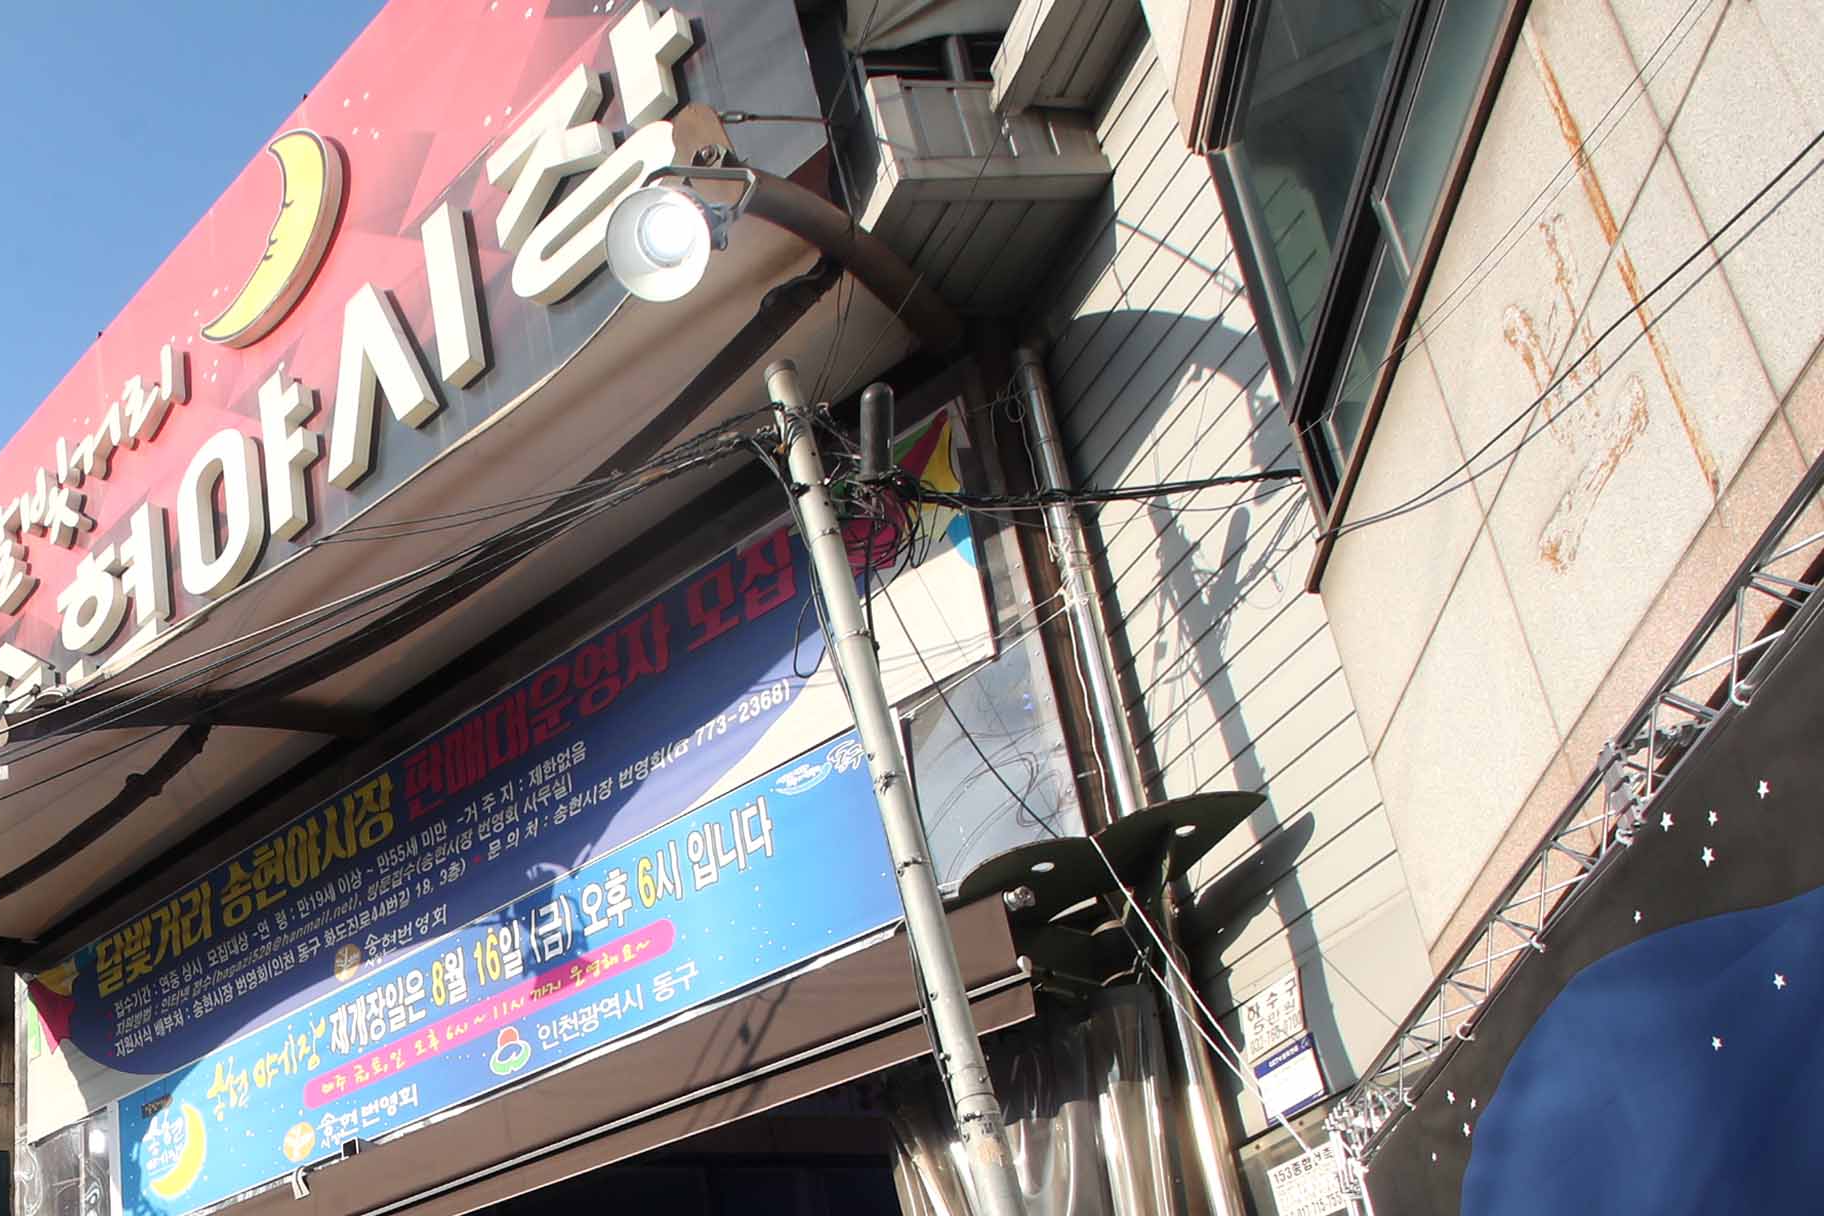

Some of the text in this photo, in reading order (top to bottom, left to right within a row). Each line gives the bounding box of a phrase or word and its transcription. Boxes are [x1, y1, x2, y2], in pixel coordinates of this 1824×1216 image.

[96, 526, 800, 998] 달빛거리 송현야시장 판매대운영자 모집
[553, 777, 614, 825] 송현시장
[182, 957, 203, 982] 상시
[207, 931, 249, 967] 모집대상
[338, 868, 363, 894] 이상
[377, 839, 418, 873] 만55세
[422, 819, 448, 848] 미만
[528, 740, 587, 788] 제한없음
[477, 803, 520, 841] 번영회
[329, 970, 426, 1056] 재개장일은
[431, 947, 469, 1007] 8월
[473, 919, 525, 986] 16일
[530, 894, 574, 964] (금)
[581, 867, 633, 936] 오후
[636, 841, 684, 909] 6시
[686, 795, 775, 891] 입니다
[192, 985, 234, 1019] 송현시장
[297, 938, 321, 963] 동구
[537, 960, 699, 1051] 인천광역시 동구
